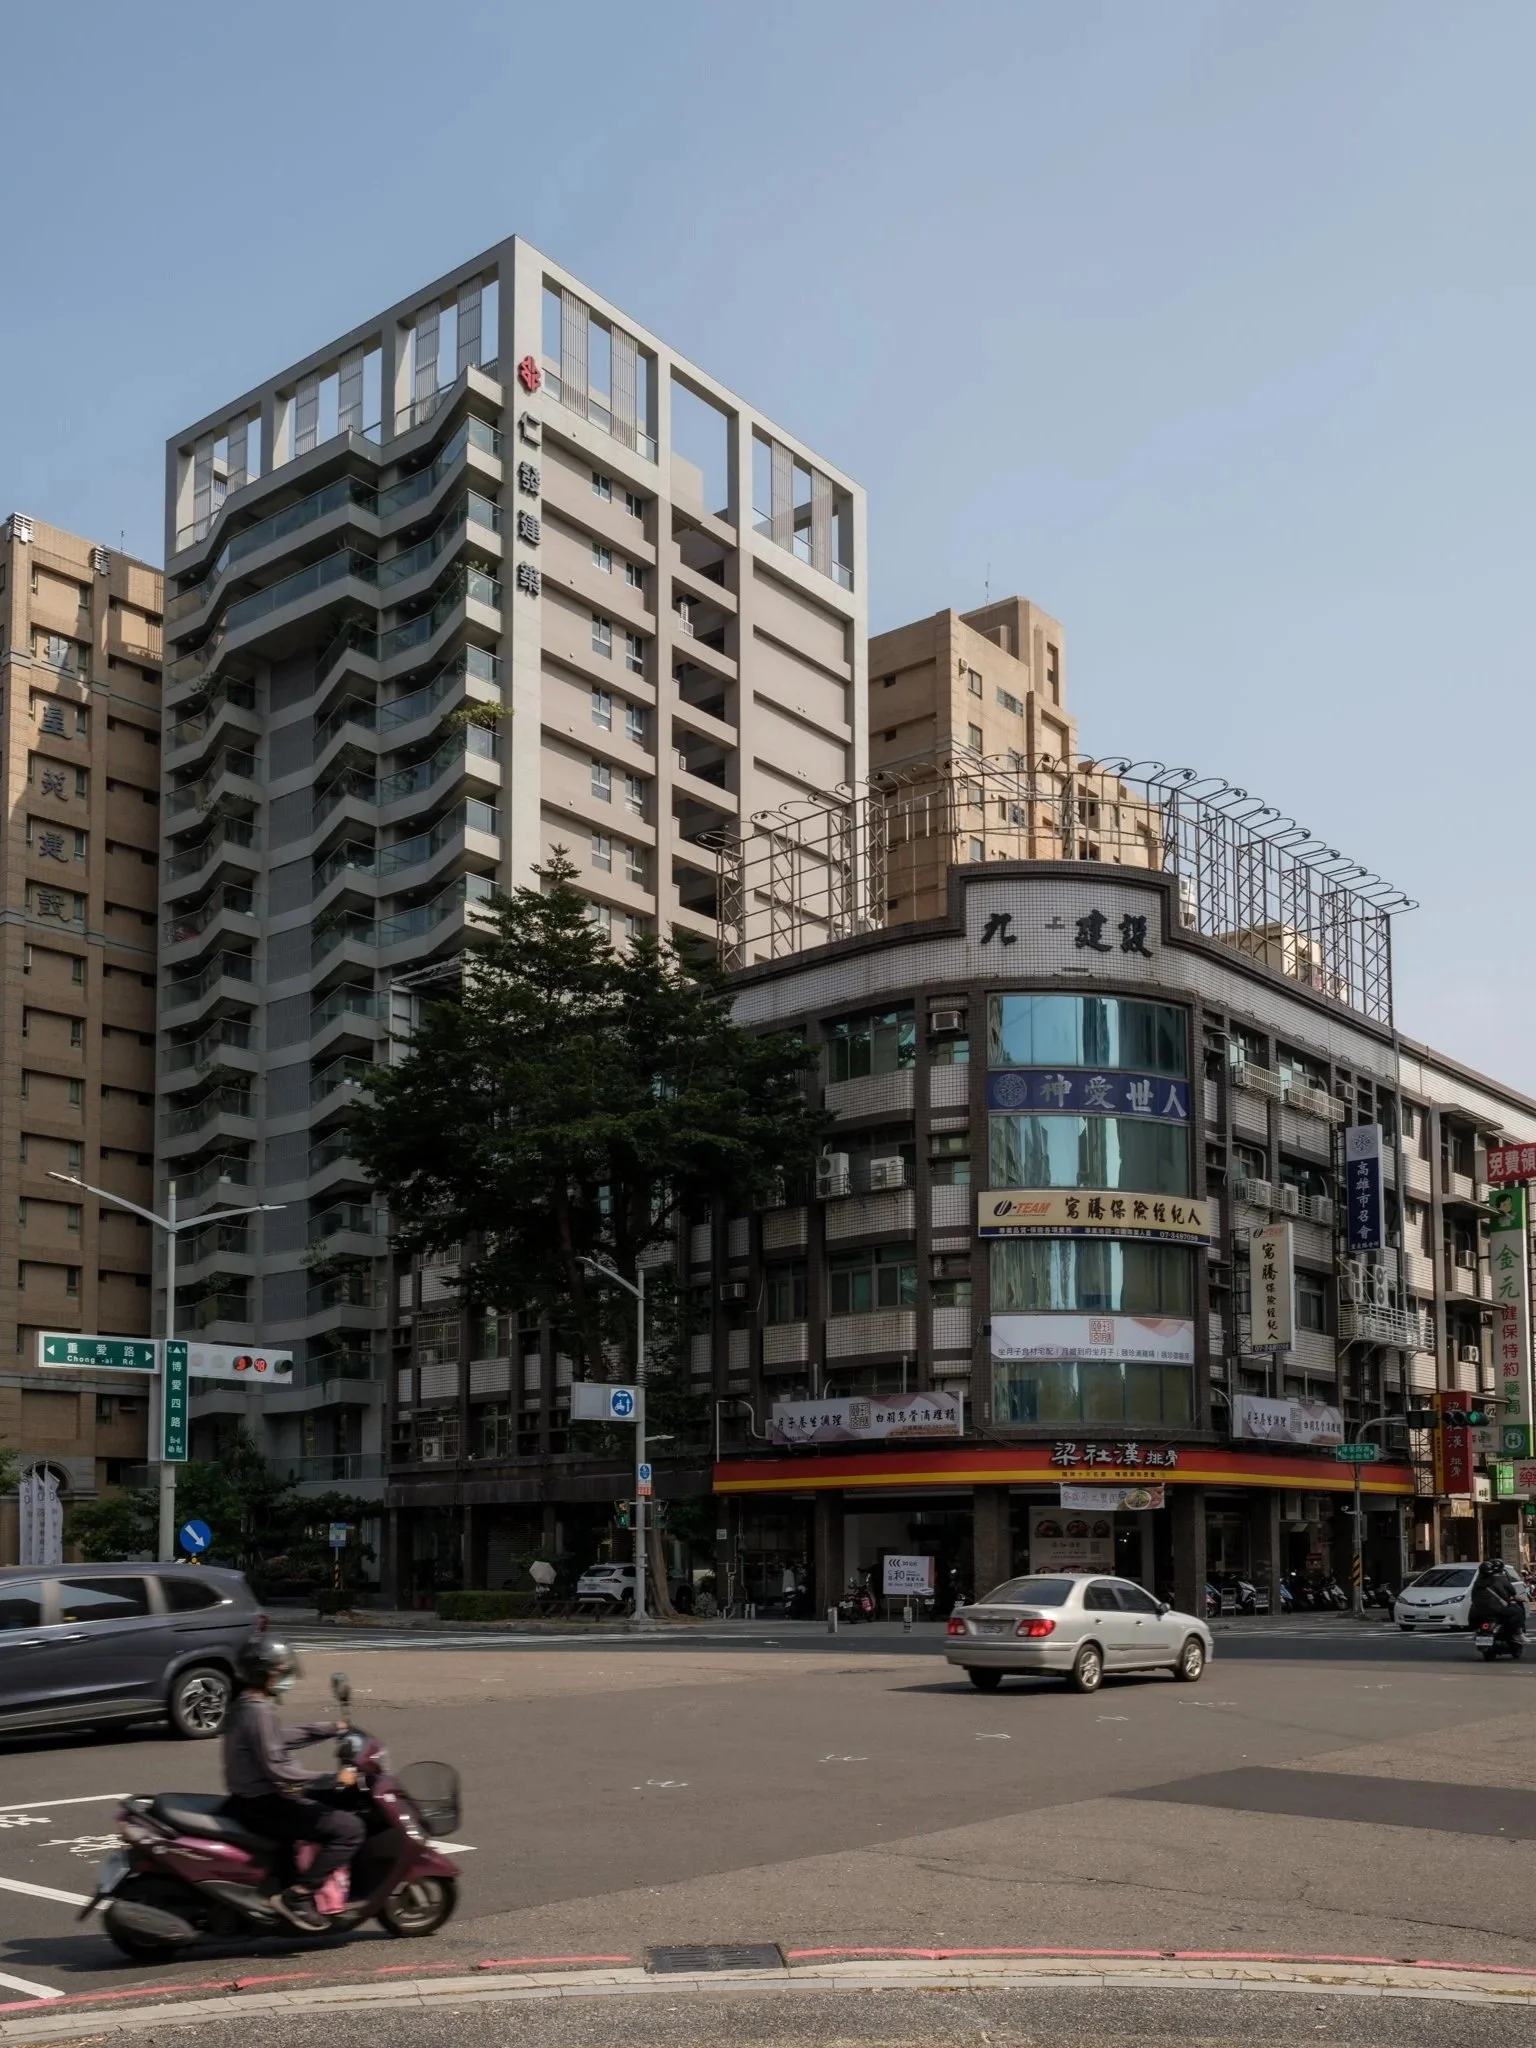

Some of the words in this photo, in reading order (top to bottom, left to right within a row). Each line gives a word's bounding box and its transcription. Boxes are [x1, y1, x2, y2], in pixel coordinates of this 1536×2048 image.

[1039, 1074, 1187, 1118] 神愛世人
[993, 1200, 1051, 1216] U-TEAM
[1355, 1161, 1374, 1240] 高雄市召會
[67, 1342, 135, 1357] 重愛路
[171, 1361, 182, 1428] 博愛四路
